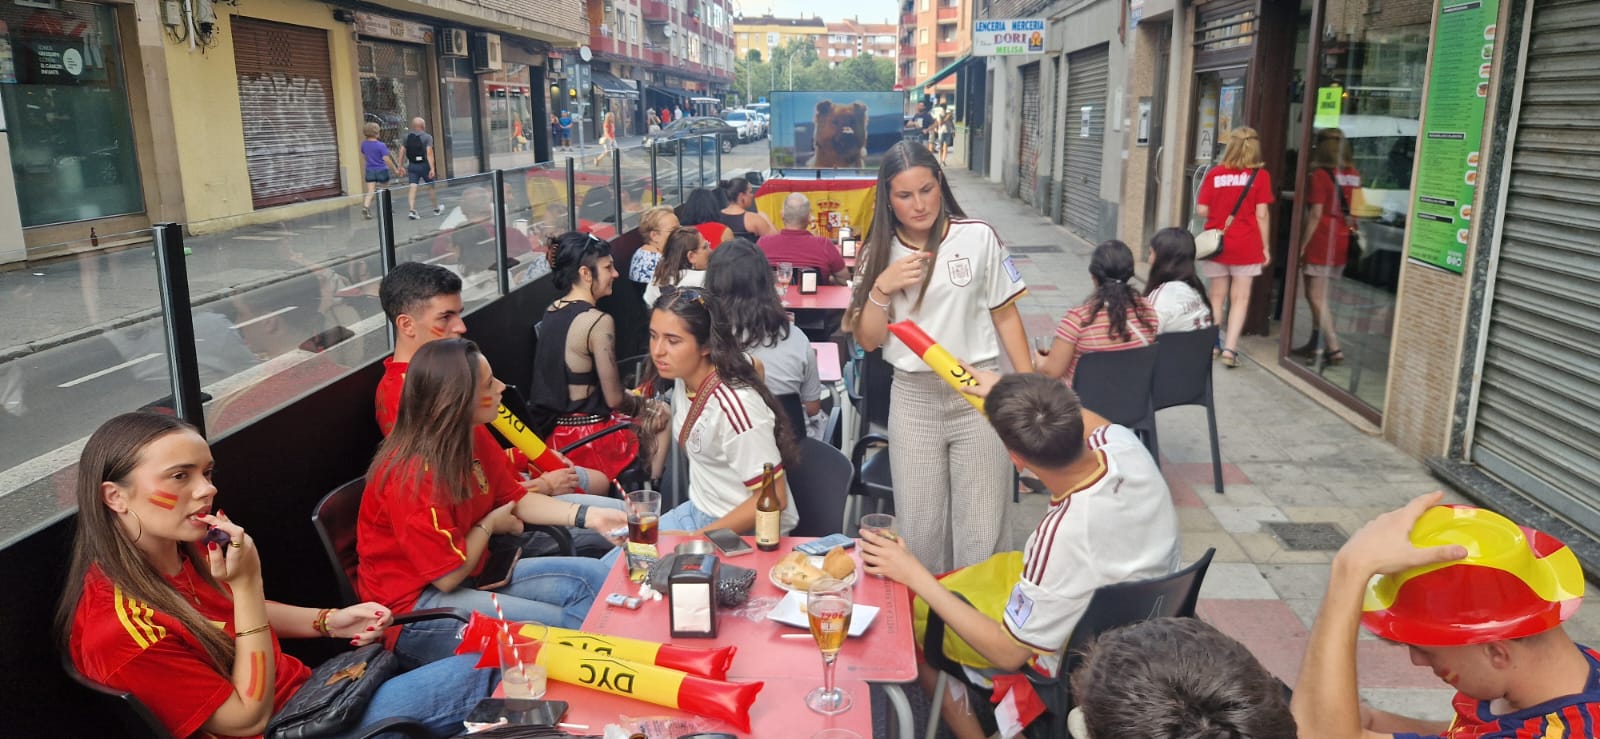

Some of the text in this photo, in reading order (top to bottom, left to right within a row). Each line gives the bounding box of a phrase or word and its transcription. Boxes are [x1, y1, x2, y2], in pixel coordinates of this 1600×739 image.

[1012, 20, 1044, 31] MERCERIA
[996, 45, 1024, 54] MELISA
[1214, 172, 1254, 188] ESPAÑ
[578, 664, 634, 694] DYC
